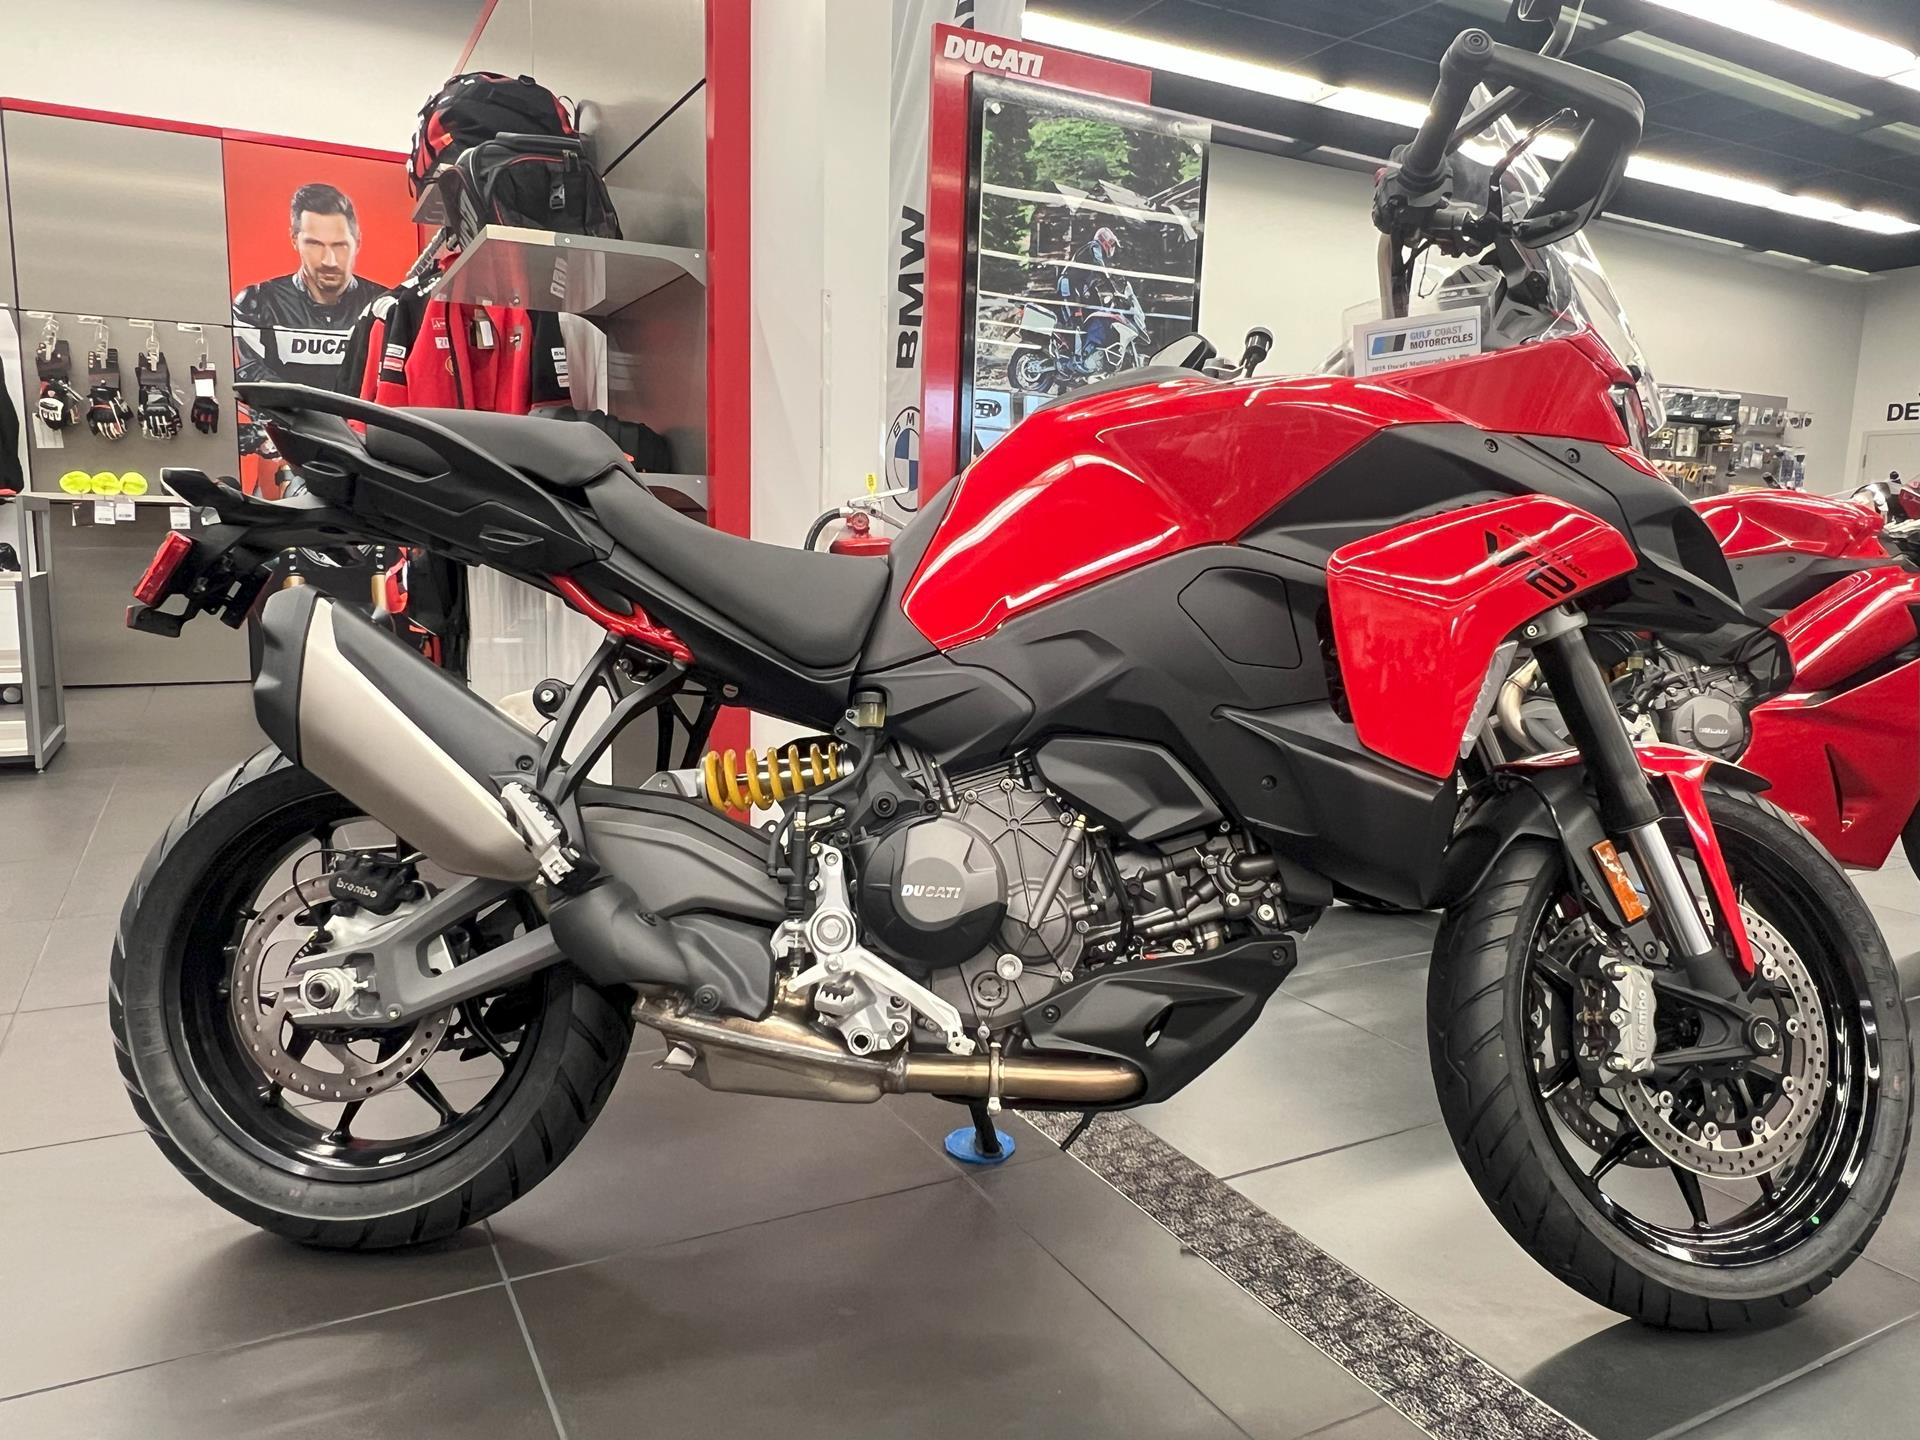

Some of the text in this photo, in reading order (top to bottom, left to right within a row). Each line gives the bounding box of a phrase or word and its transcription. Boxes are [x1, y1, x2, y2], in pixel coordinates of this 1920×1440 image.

[943, 34, 1044, 78] DUCATI
[896, 205, 925, 369] BMW
[1410, 326, 1463, 341] GULF COAST
[1410, 333, 1474, 350] MOTORCYCLES
[335, 877, 378, 898] brembo
[901, 884, 962, 899] DUCATI
[1635, 989, 1648, 1053] brembo
